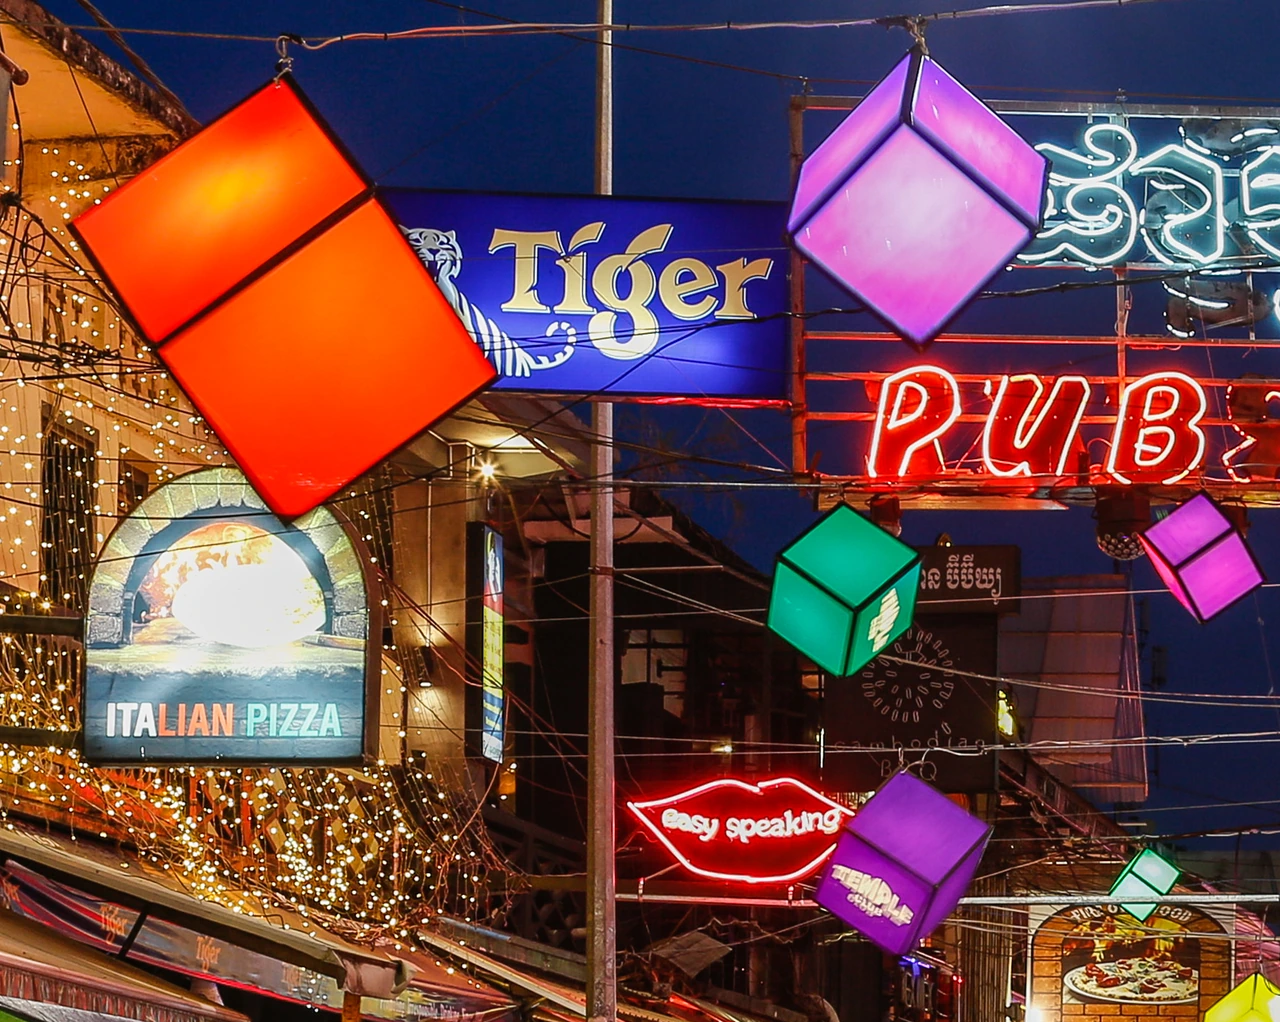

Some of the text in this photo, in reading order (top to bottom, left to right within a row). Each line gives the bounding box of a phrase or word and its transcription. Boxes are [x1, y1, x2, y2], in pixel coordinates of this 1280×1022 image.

[488, 221, 773, 361] Tiger
[866, 364, 1207, 486] PUB
[106, 700, 344, 739] ITALIAN PIZZA
[661, 808, 842, 843] easy speaking
[831, 864, 915, 926] TEMPLE
[1158, 904, 1193, 922] OOD
